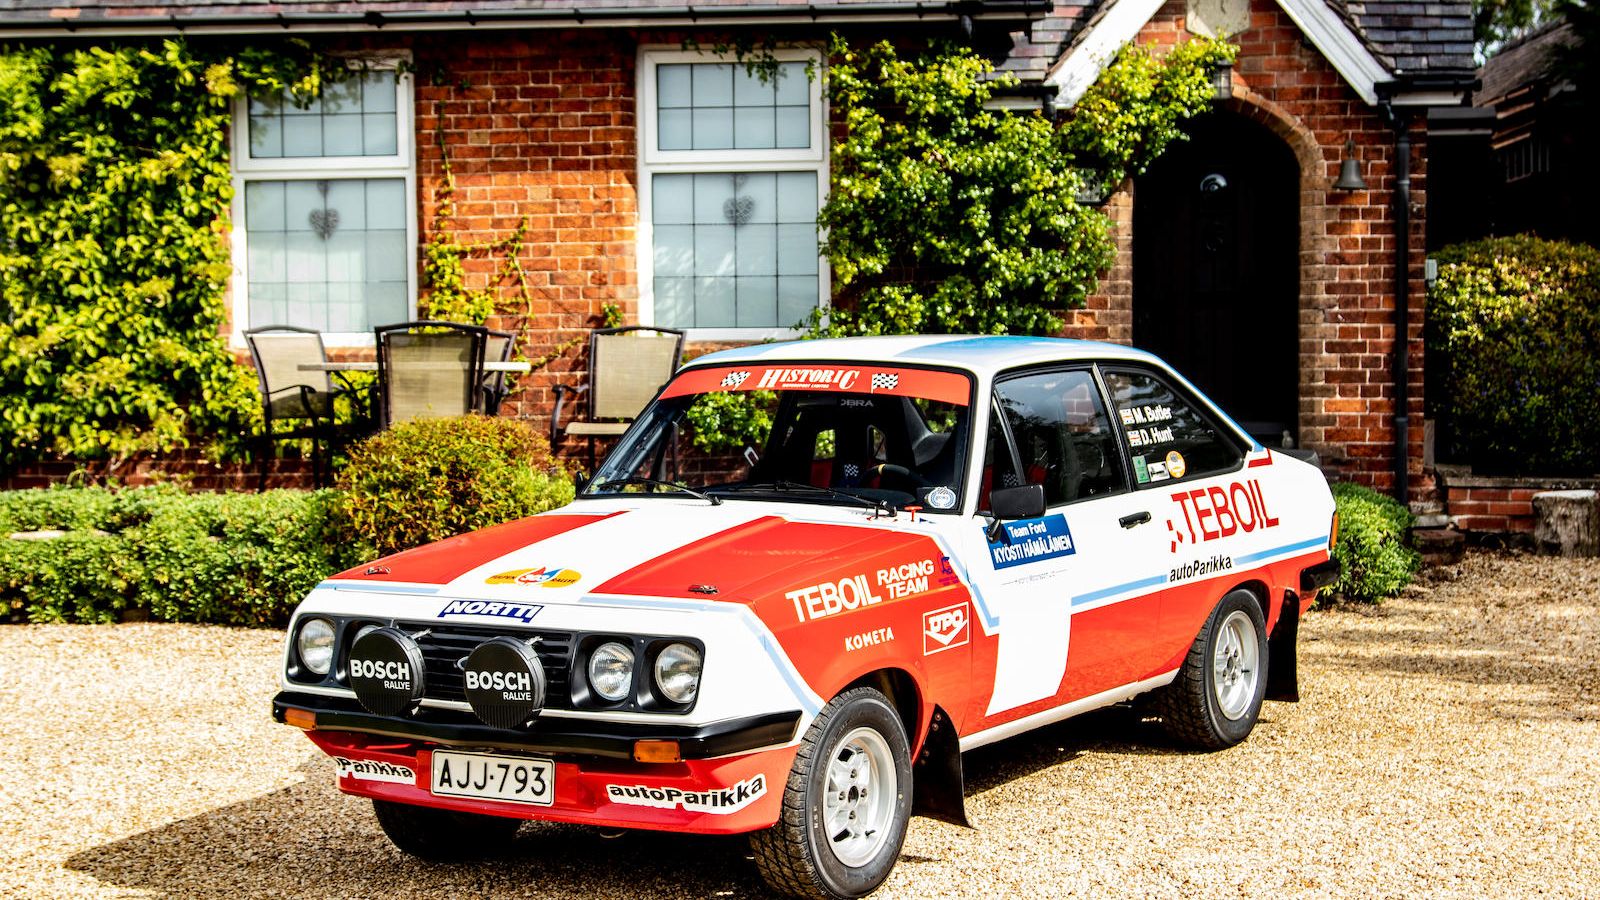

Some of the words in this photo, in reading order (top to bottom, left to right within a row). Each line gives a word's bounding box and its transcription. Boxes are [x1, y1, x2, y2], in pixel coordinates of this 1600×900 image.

[756, 369, 860, 389] HISTORIC
[1132, 407, 1147, 424] M.
[1144, 405, 1172, 422] Butler
[1139, 429, 1153, 445] D.
[1150, 427, 1174, 444] Hunt
[1171, 479, 1279, 544] TEBOIL
[1008, 526, 1030, 538] Team
[1028, 521, 1047, 534] Ford
[993, 544, 1024, 563] KYÖSTI
[876, 560, 934, 586] RACING
[1170, 554, 1232, 582] autoParikka
[886, 576, 928, 599] TEAM
[785, 574, 882, 622] TEBOIL
[446, 601, 541, 618] NORTTI
[929, 610, 964, 633] UPO
[845, 627, 894, 652] KOMETA
[350, 660, 410, 680] BOSCH
[384, 680, 411, 691] RALLYE
[465, 671, 531, 691] BOSCH
[503, 691, 532, 701] RALLYE
[609, 777, 763, 807] autoParikka
